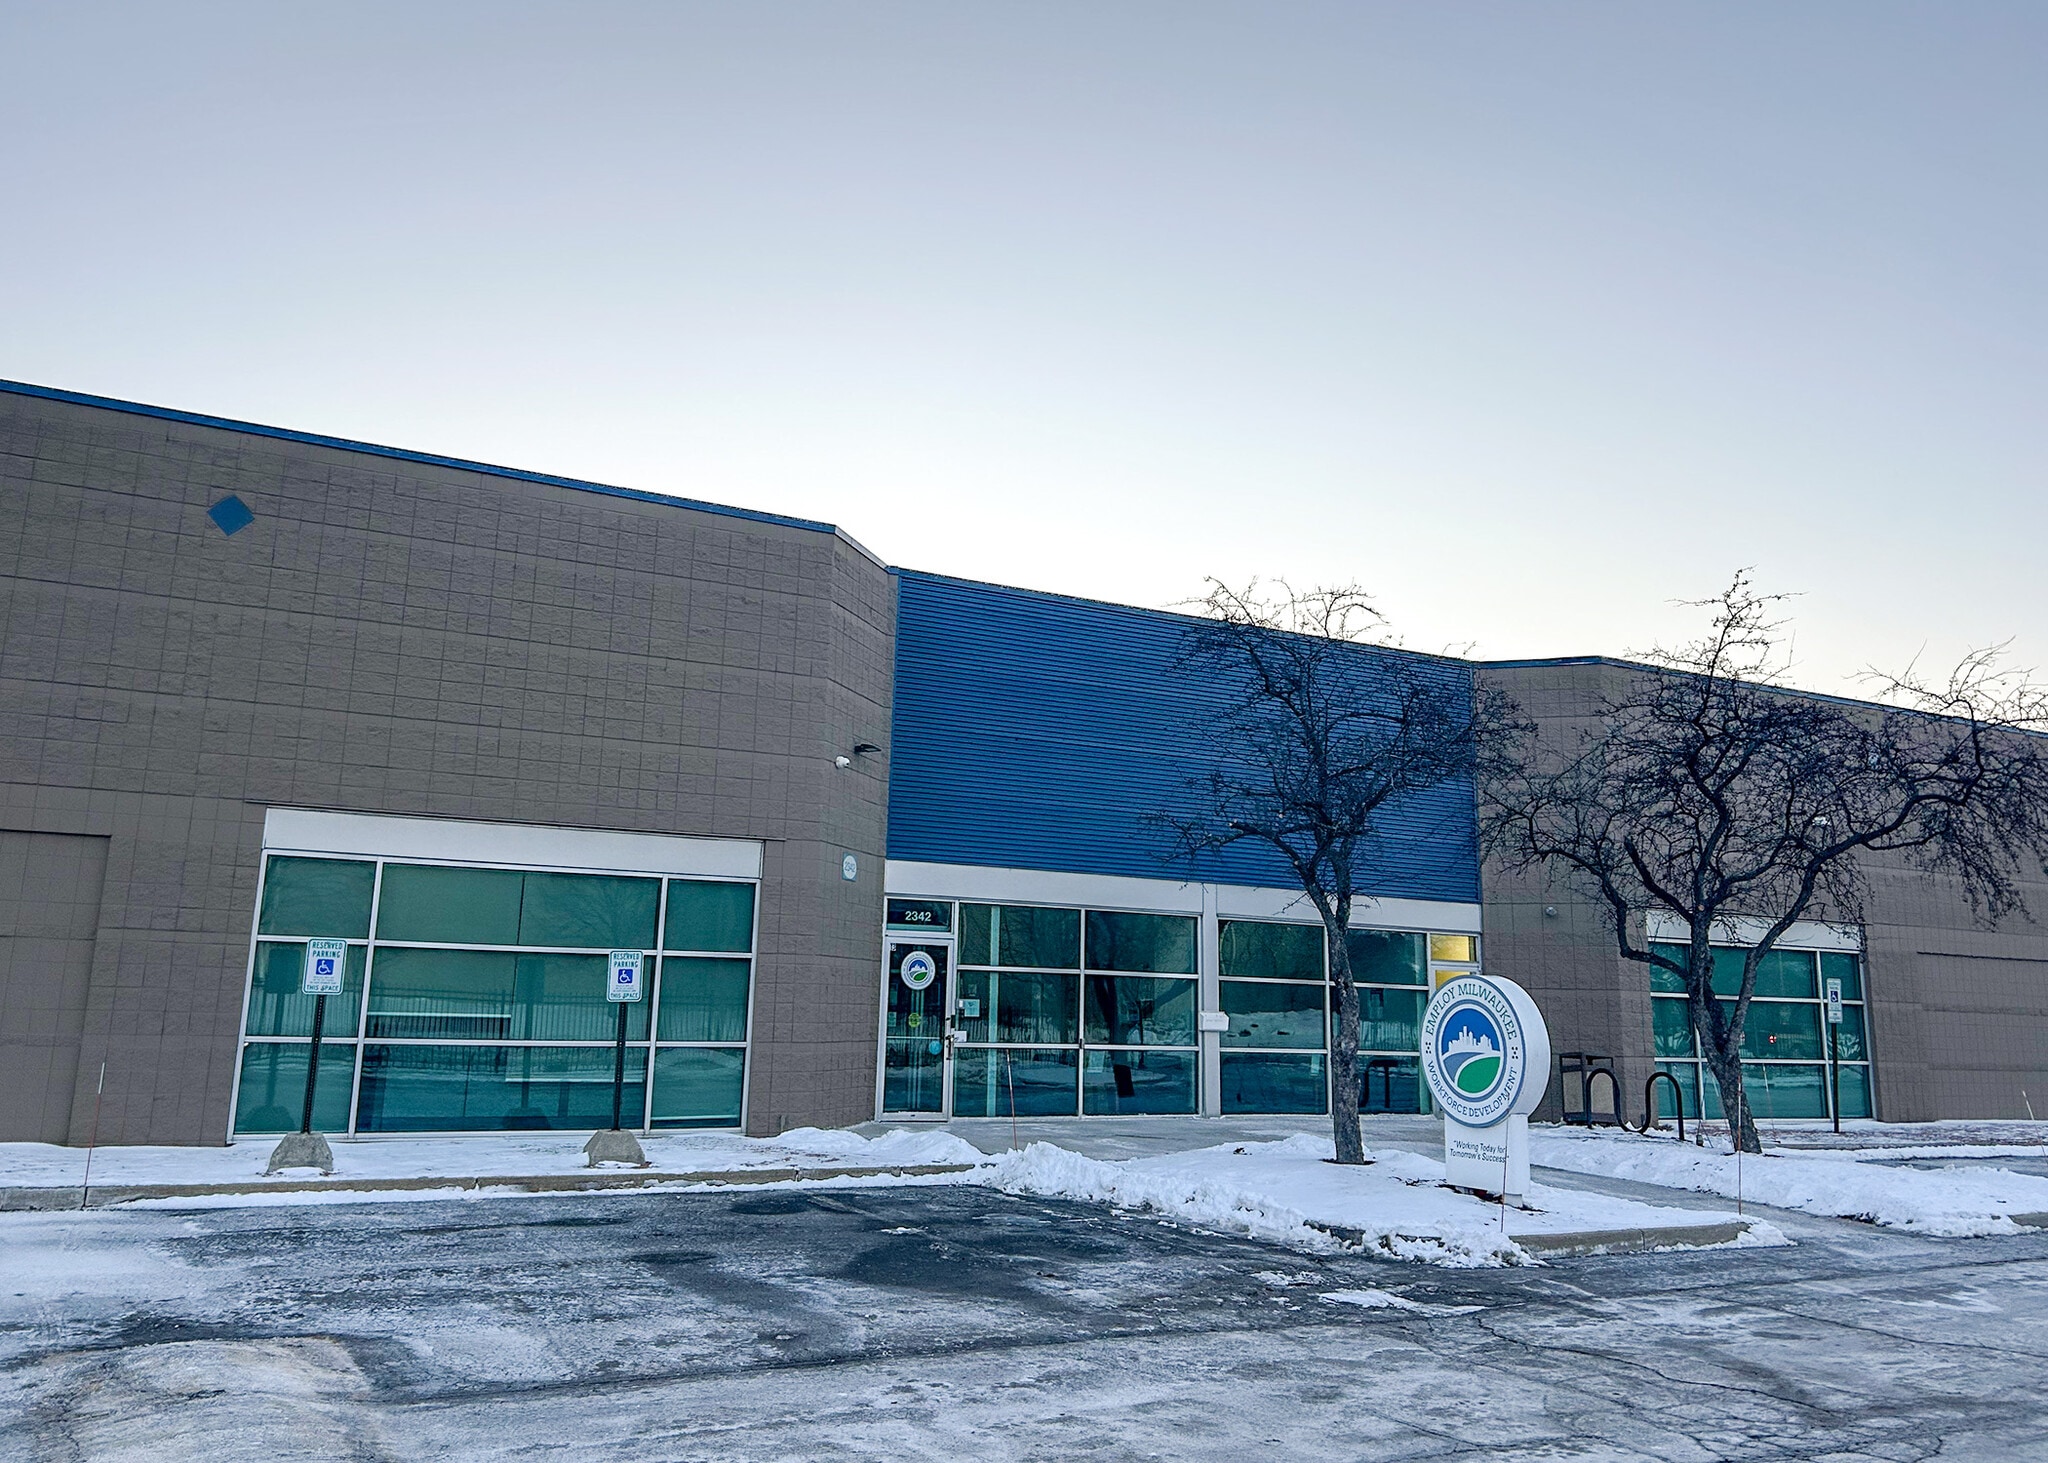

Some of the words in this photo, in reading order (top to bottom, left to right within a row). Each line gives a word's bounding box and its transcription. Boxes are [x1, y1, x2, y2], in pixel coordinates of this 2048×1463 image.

[905, 911, 931, 921] 2342
[312, 950, 341, 958] PARKING
[1426, 987, 1455, 1036] EMPLOY
[1458, 983, 1517, 1040] MILWAUKEE
[1428, 1060, 1470, 1116] WORKFORCE
[1468, 1066, 1517, 1118] DEVELOPMENT
[1450, 1148, 1481, 1160] Tomorrow's
[1480, 1143, 1496, 1154] Today
[1497, 1145, 1506, 1154] for
